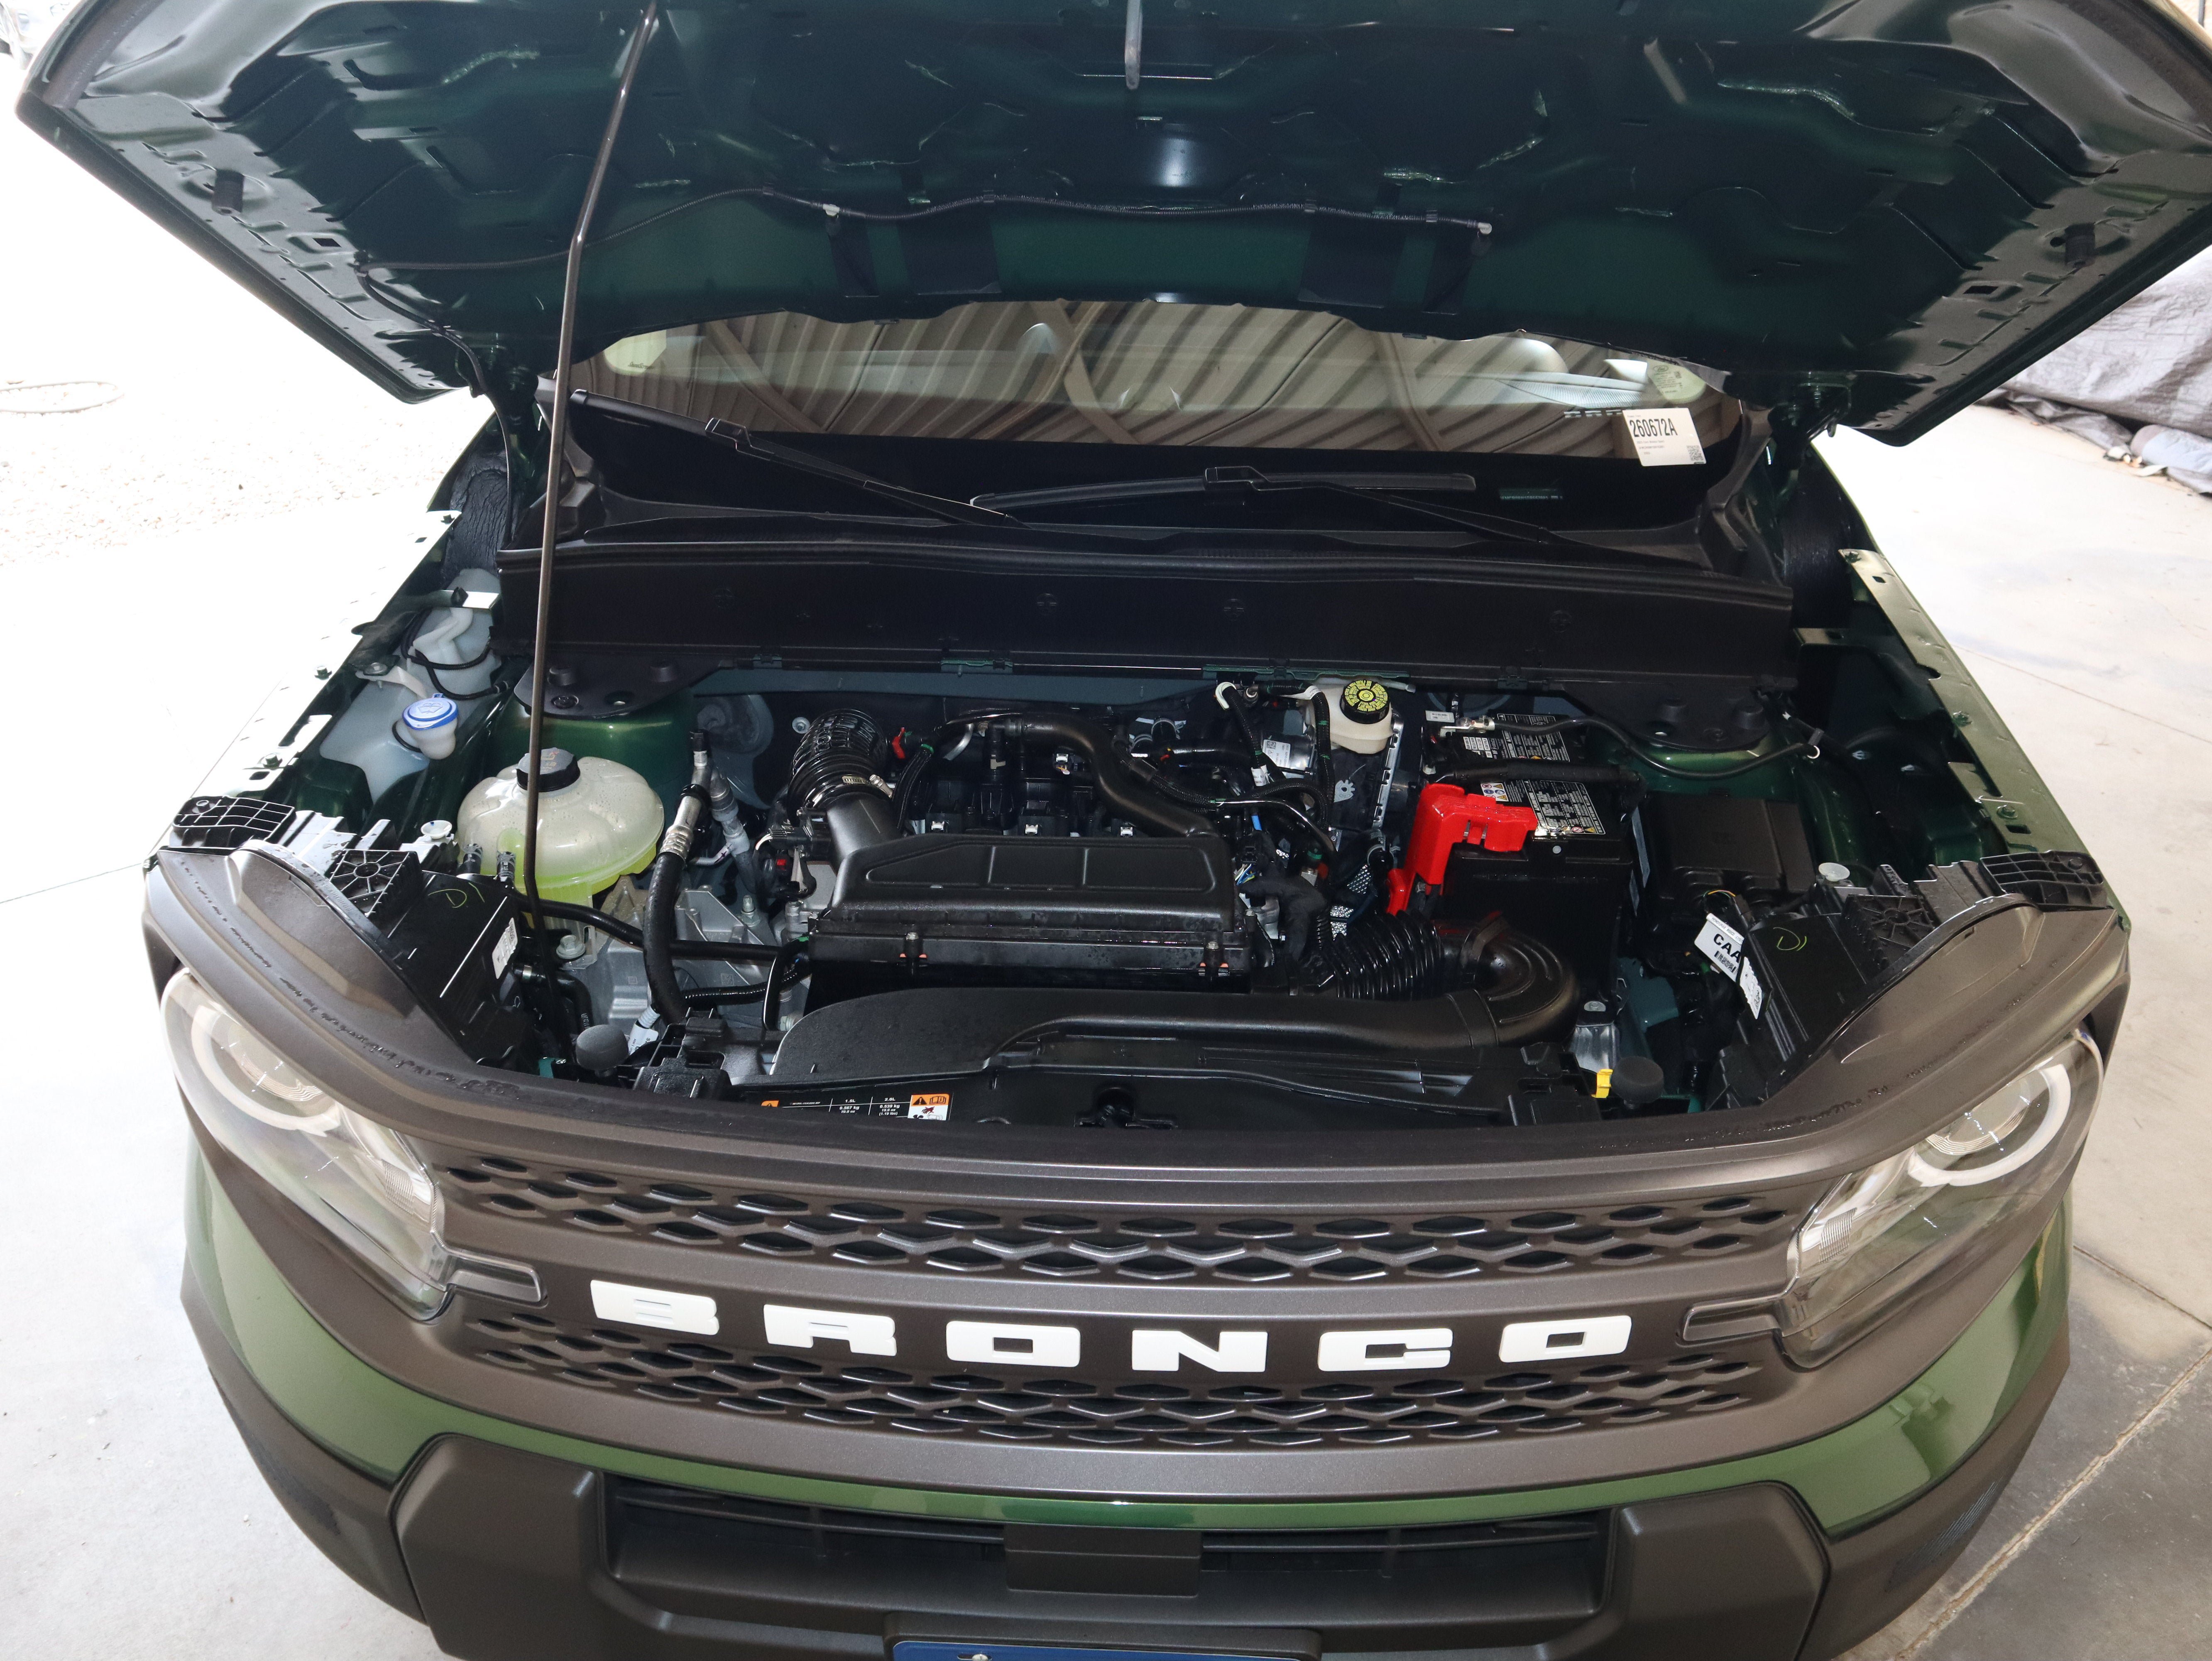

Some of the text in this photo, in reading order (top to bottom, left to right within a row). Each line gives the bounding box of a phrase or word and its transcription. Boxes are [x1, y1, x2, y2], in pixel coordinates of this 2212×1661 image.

[1630, 418, 1678, 437] 260672A
[1713, 933, 1742, 963] CAA
[590, 1279, 1632, 1373] BRONCO
